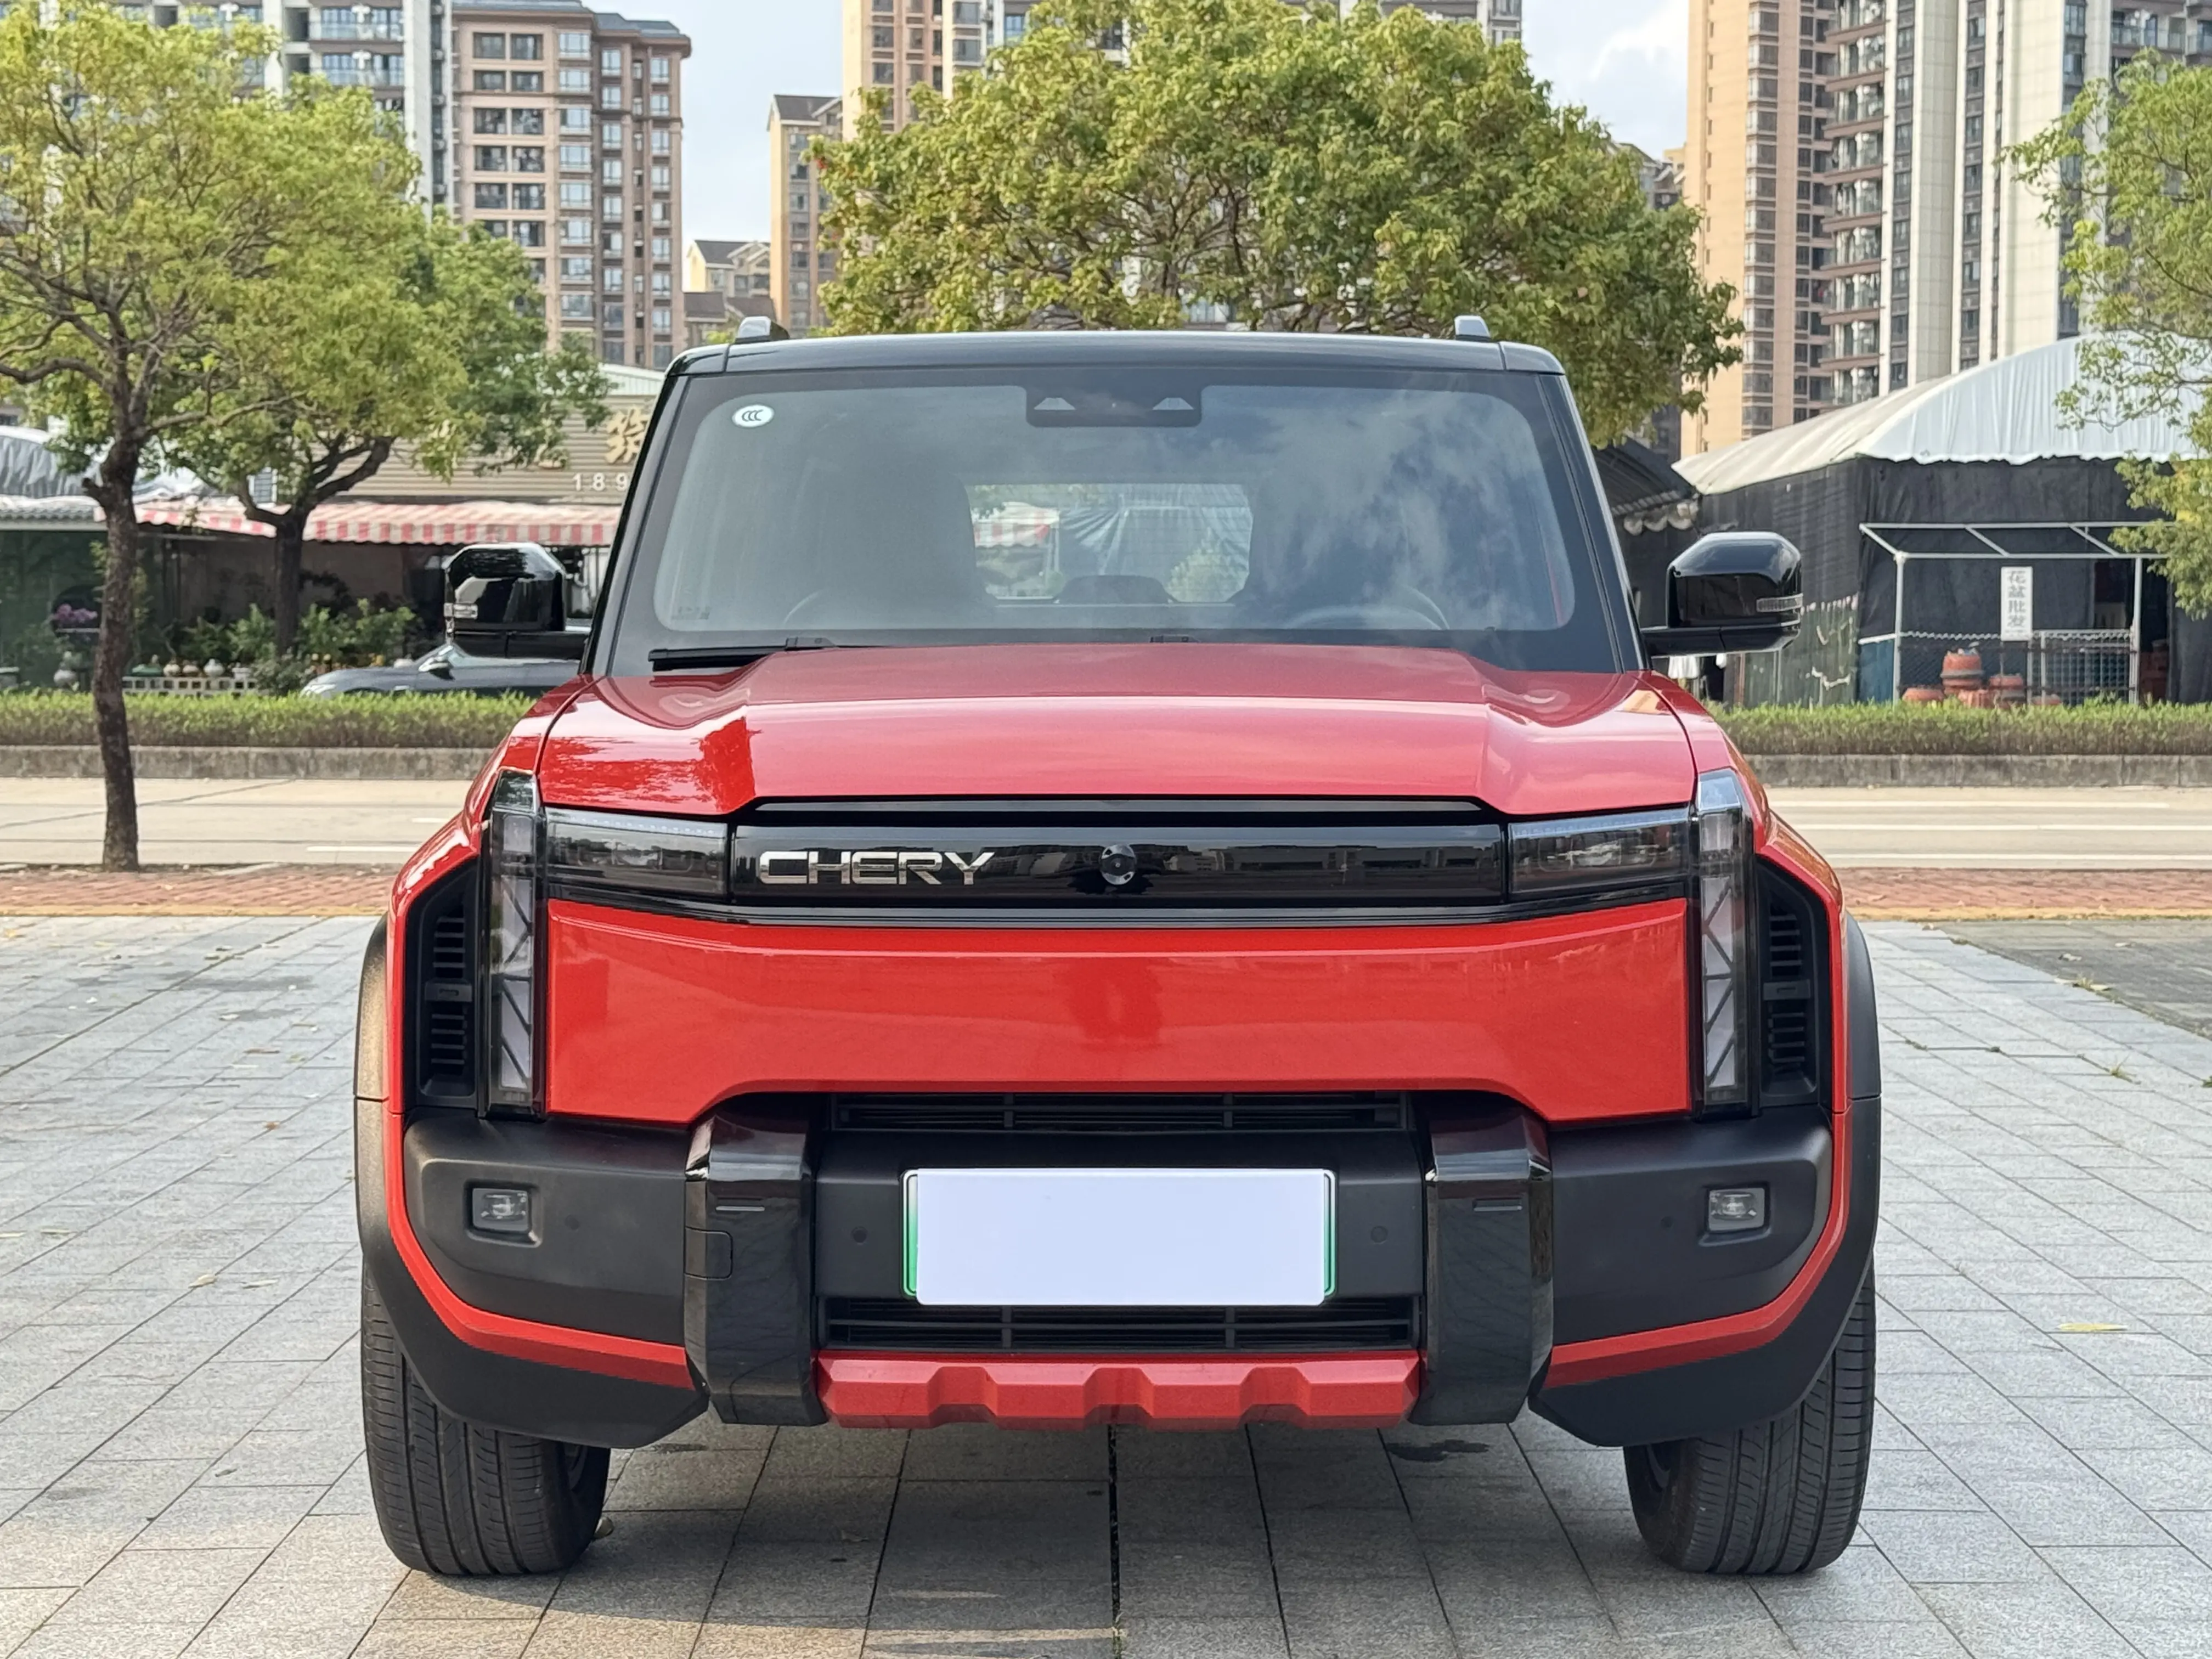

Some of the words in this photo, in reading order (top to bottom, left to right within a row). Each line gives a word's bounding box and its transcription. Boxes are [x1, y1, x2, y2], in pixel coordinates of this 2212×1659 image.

[2006, 570, 2027, 628] 花盆批发
[759, 851, 995, 885] CHERY
